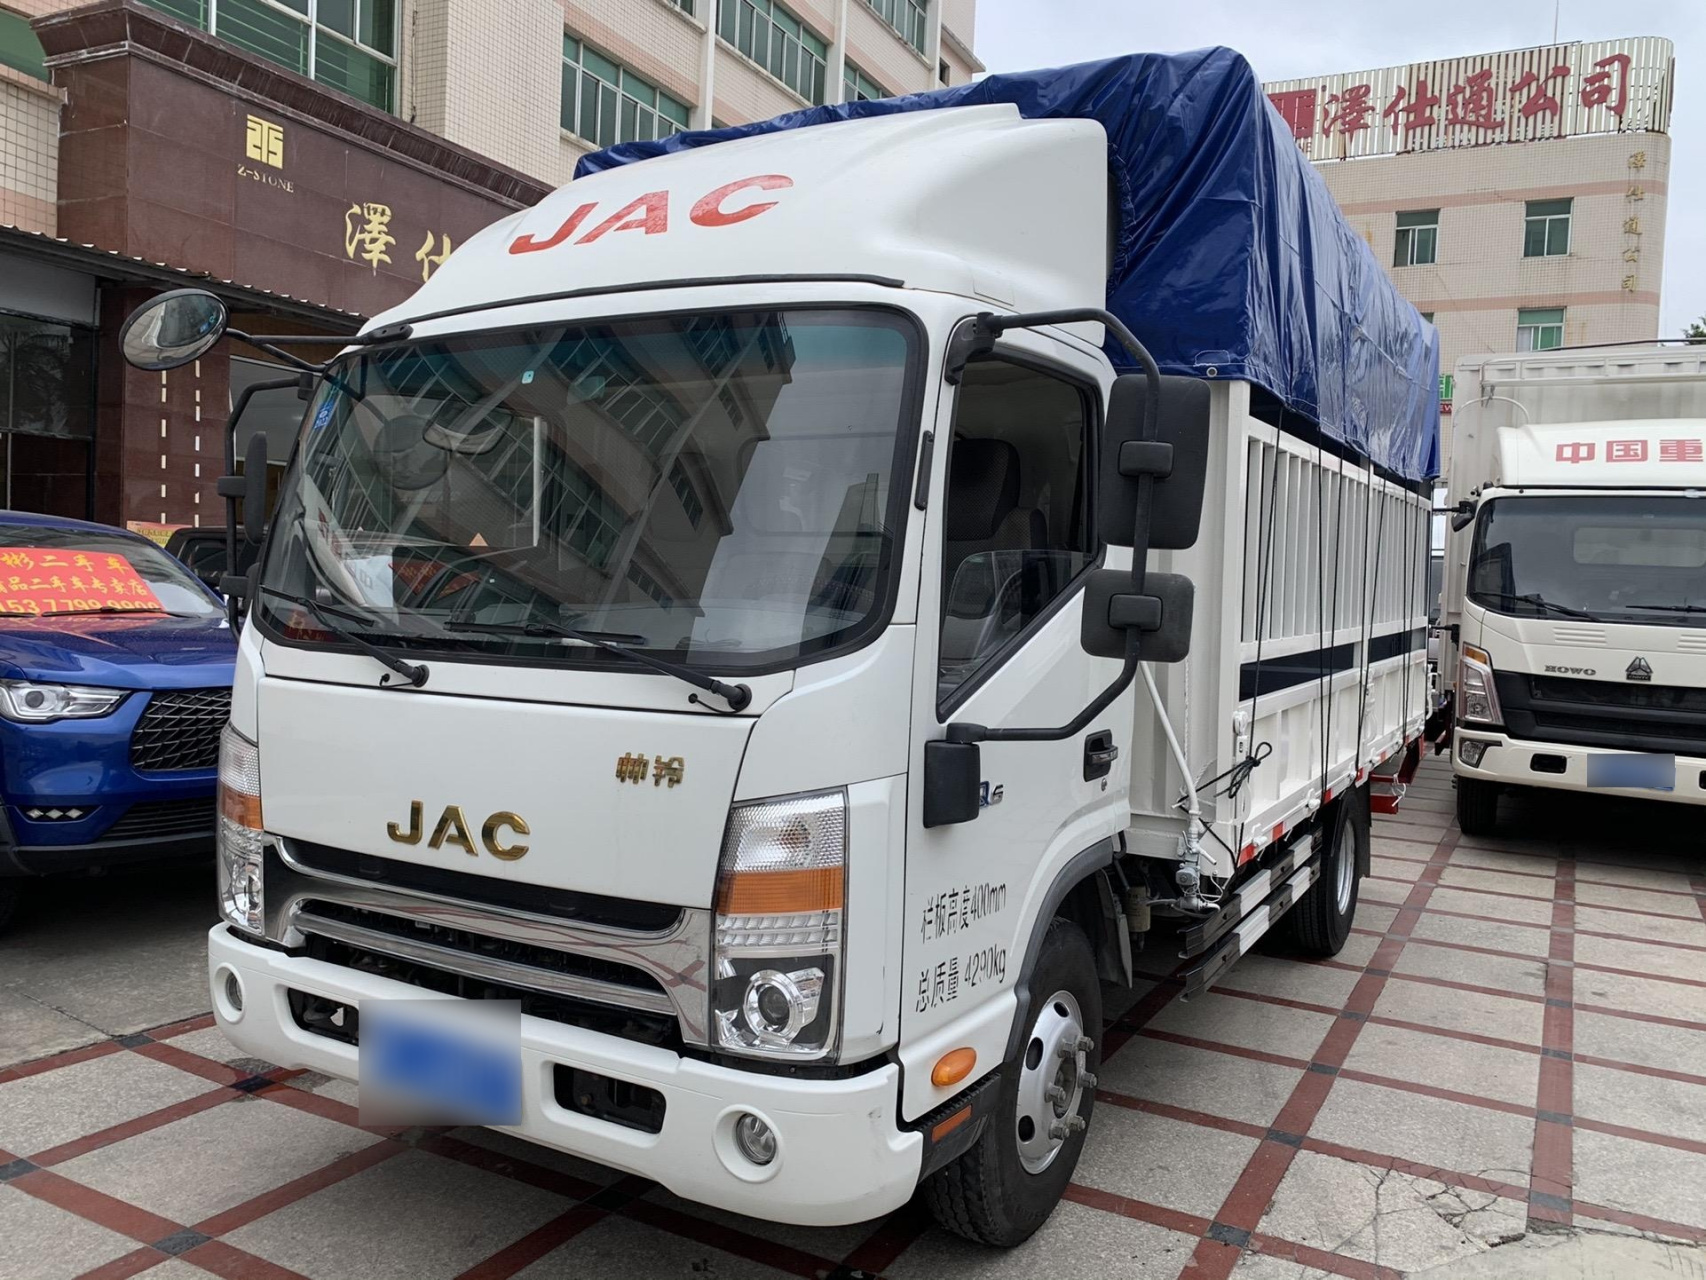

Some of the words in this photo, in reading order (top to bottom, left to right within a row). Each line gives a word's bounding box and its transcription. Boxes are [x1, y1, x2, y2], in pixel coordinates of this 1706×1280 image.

[237, 163, 294, 193] Z-STONE
[508, 174, 794, 255] JAC
[1555, 439, 1704, 464] 中国重
[1544, 665, 1597, 676] HOWO
[386, 799, 531, 861] JAC
[915, 956, 959, 1013] 总质量
[964, 943, 1007, 987] 4290kg
